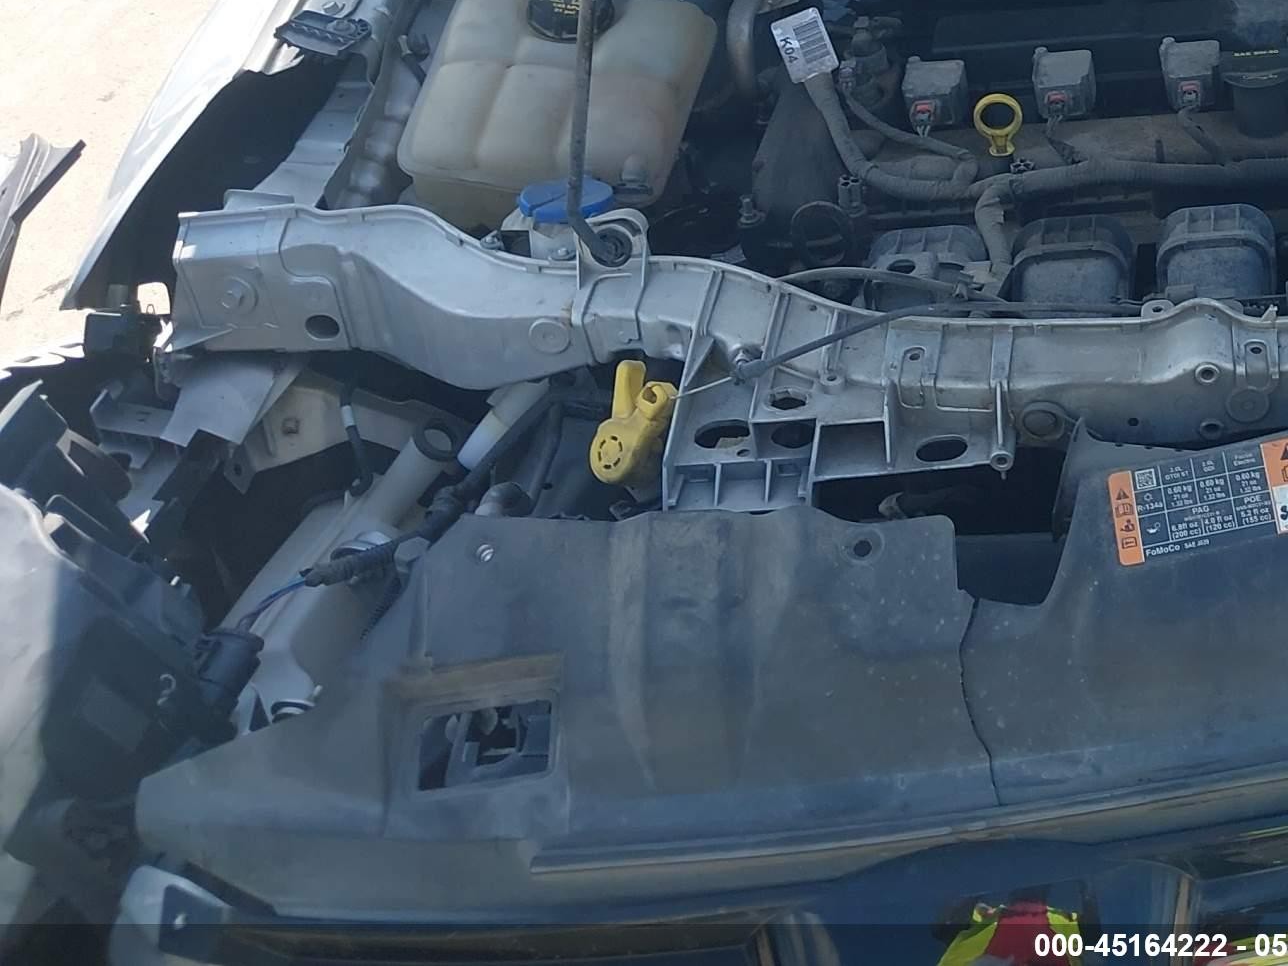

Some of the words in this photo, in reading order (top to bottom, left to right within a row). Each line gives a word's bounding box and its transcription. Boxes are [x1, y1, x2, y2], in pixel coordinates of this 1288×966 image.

[780, 37, 799, 63] K04
[1235, 472, 1250, 481] 0.60
[1250, 471, 1260, 480] kg
[1199, 479, 1214, 488] 0.60
[1214, 477, 1225, 486] kg
[1167, 485, 1182, 494] 0.60
[1182, 484, 1193, 493] kg
[1244, 495, 1262, 505] POE
[1137, 501, 1163, 512] R-134a
[1191, 505, 1210, 514] PAG
[1240, 509, 1252, 518] 5.2
[1259, 513, 1271, 523] cc)
[1204, 516, 1216, 525] 4.0
[1223, 514, 1233, 522] oz
[1205, 523, 1222, 534] (120
[1223, 521, 1235, 530] cc)
[1172, 529, 1188, 540] (200
[1189, 527, 1202, 536] cc)
[1145, 544, 1181, 557] FoMoCo
